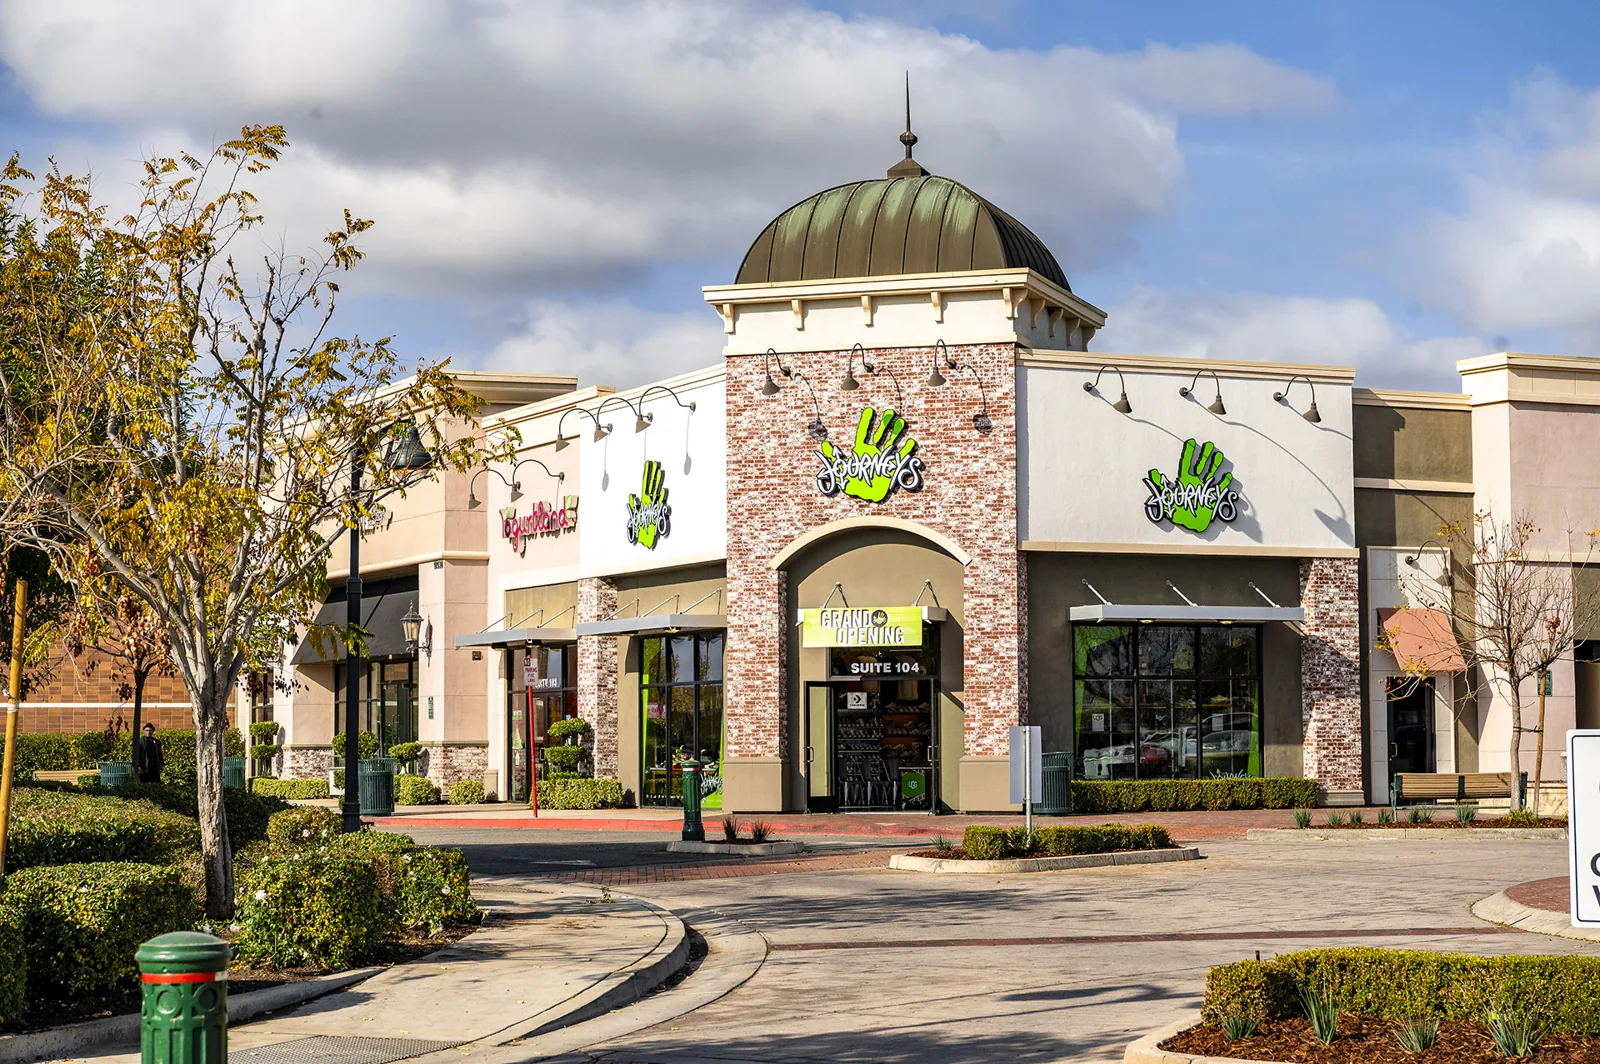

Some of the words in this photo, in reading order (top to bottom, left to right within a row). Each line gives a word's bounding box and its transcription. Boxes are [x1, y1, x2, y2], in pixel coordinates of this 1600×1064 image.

[814, 445, 921, 494] JOURNEYS
[1143, 473, 1239, 521] JOURNEYS
[821, 609, 871, 628] GRAND
[836, 626, 904, 645] OPENING
[851, 662, 891, 673] SUITE
[895, 662, 919, 673] 104
